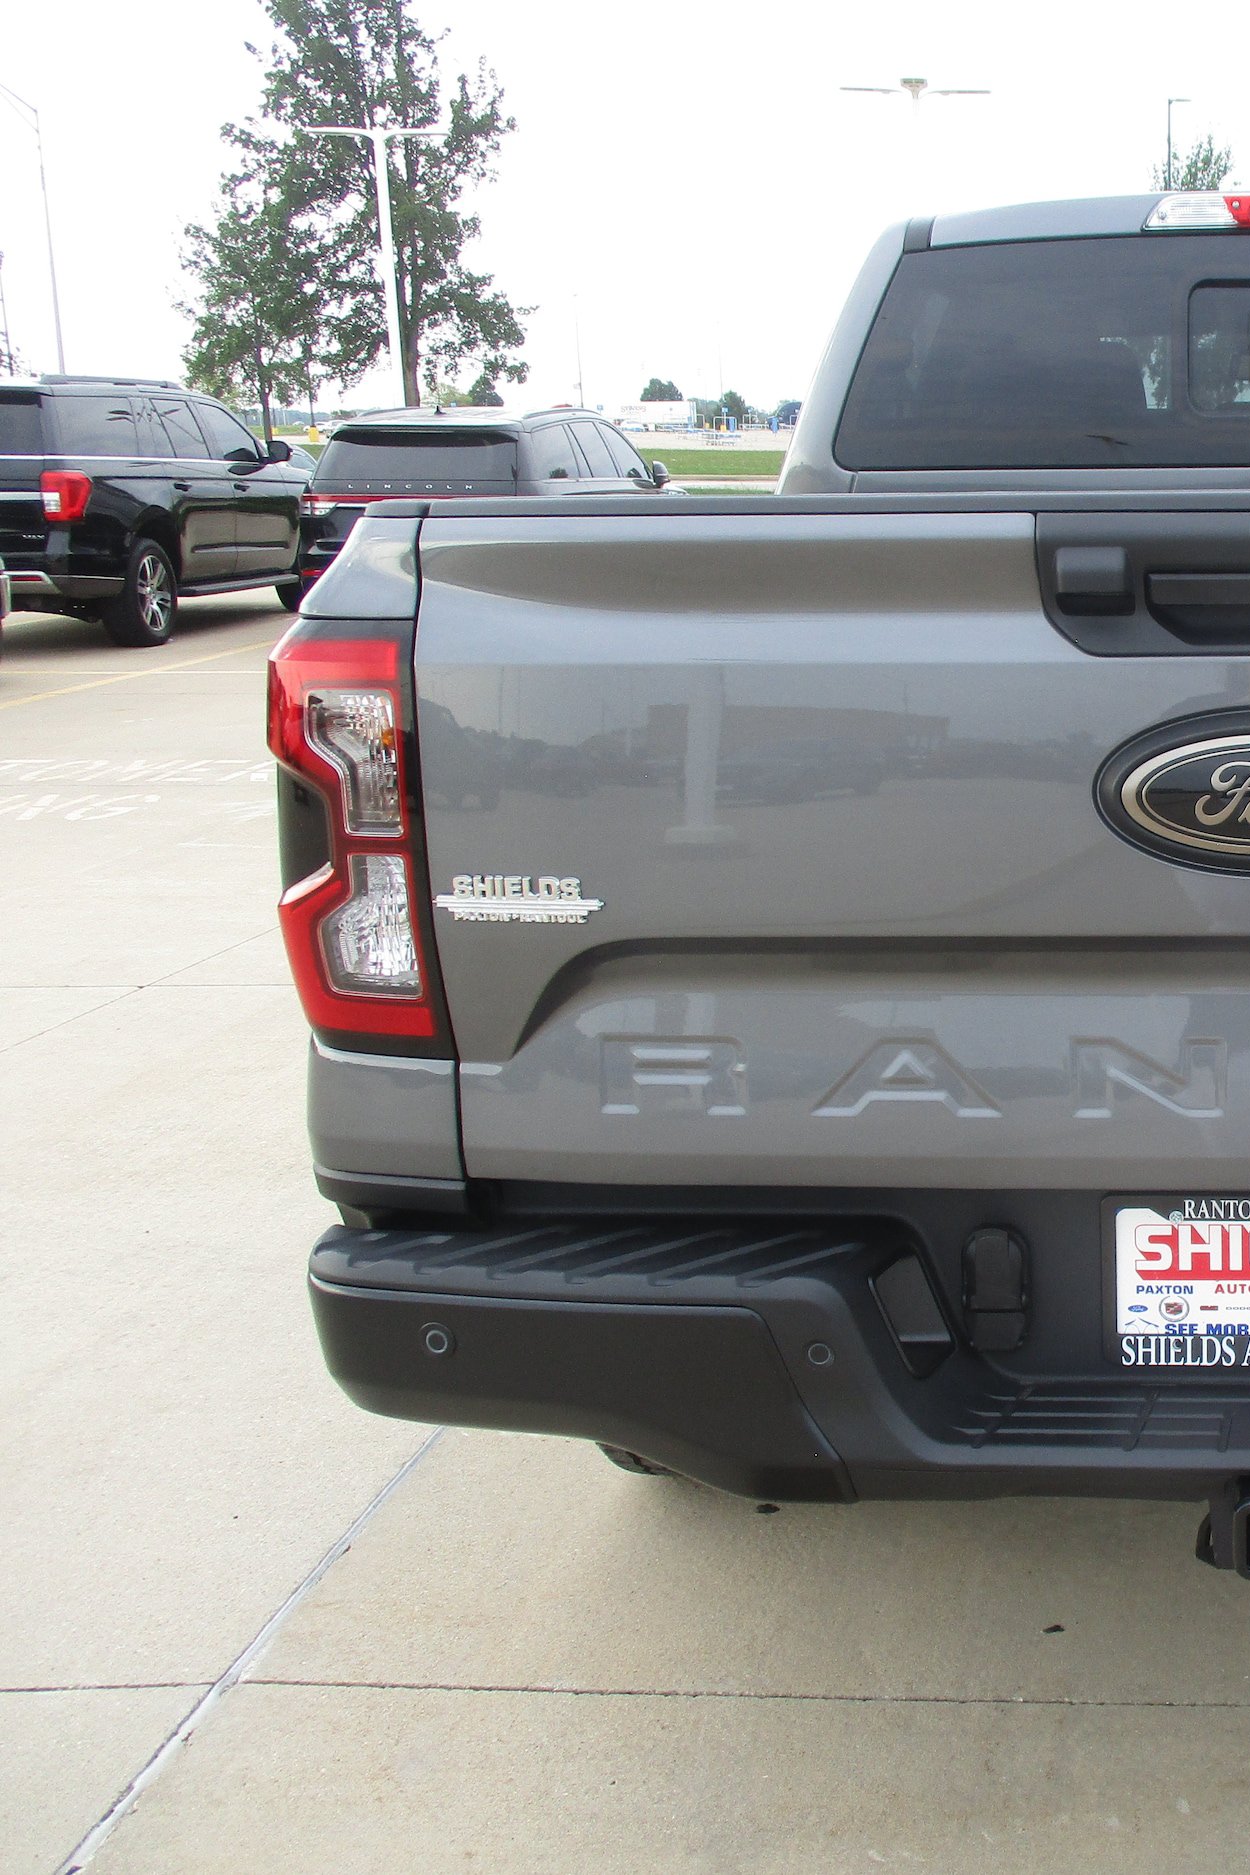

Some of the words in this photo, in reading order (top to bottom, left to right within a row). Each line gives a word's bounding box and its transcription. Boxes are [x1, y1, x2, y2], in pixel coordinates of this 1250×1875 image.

[452, 874, 582, 901] SHIELDS
[1136, 1284, 1194, 1295] PAXTON
[1164, 1323, 1199, 1336] SEE
[1121, 1336, 1236, 1367] SHIELDS
